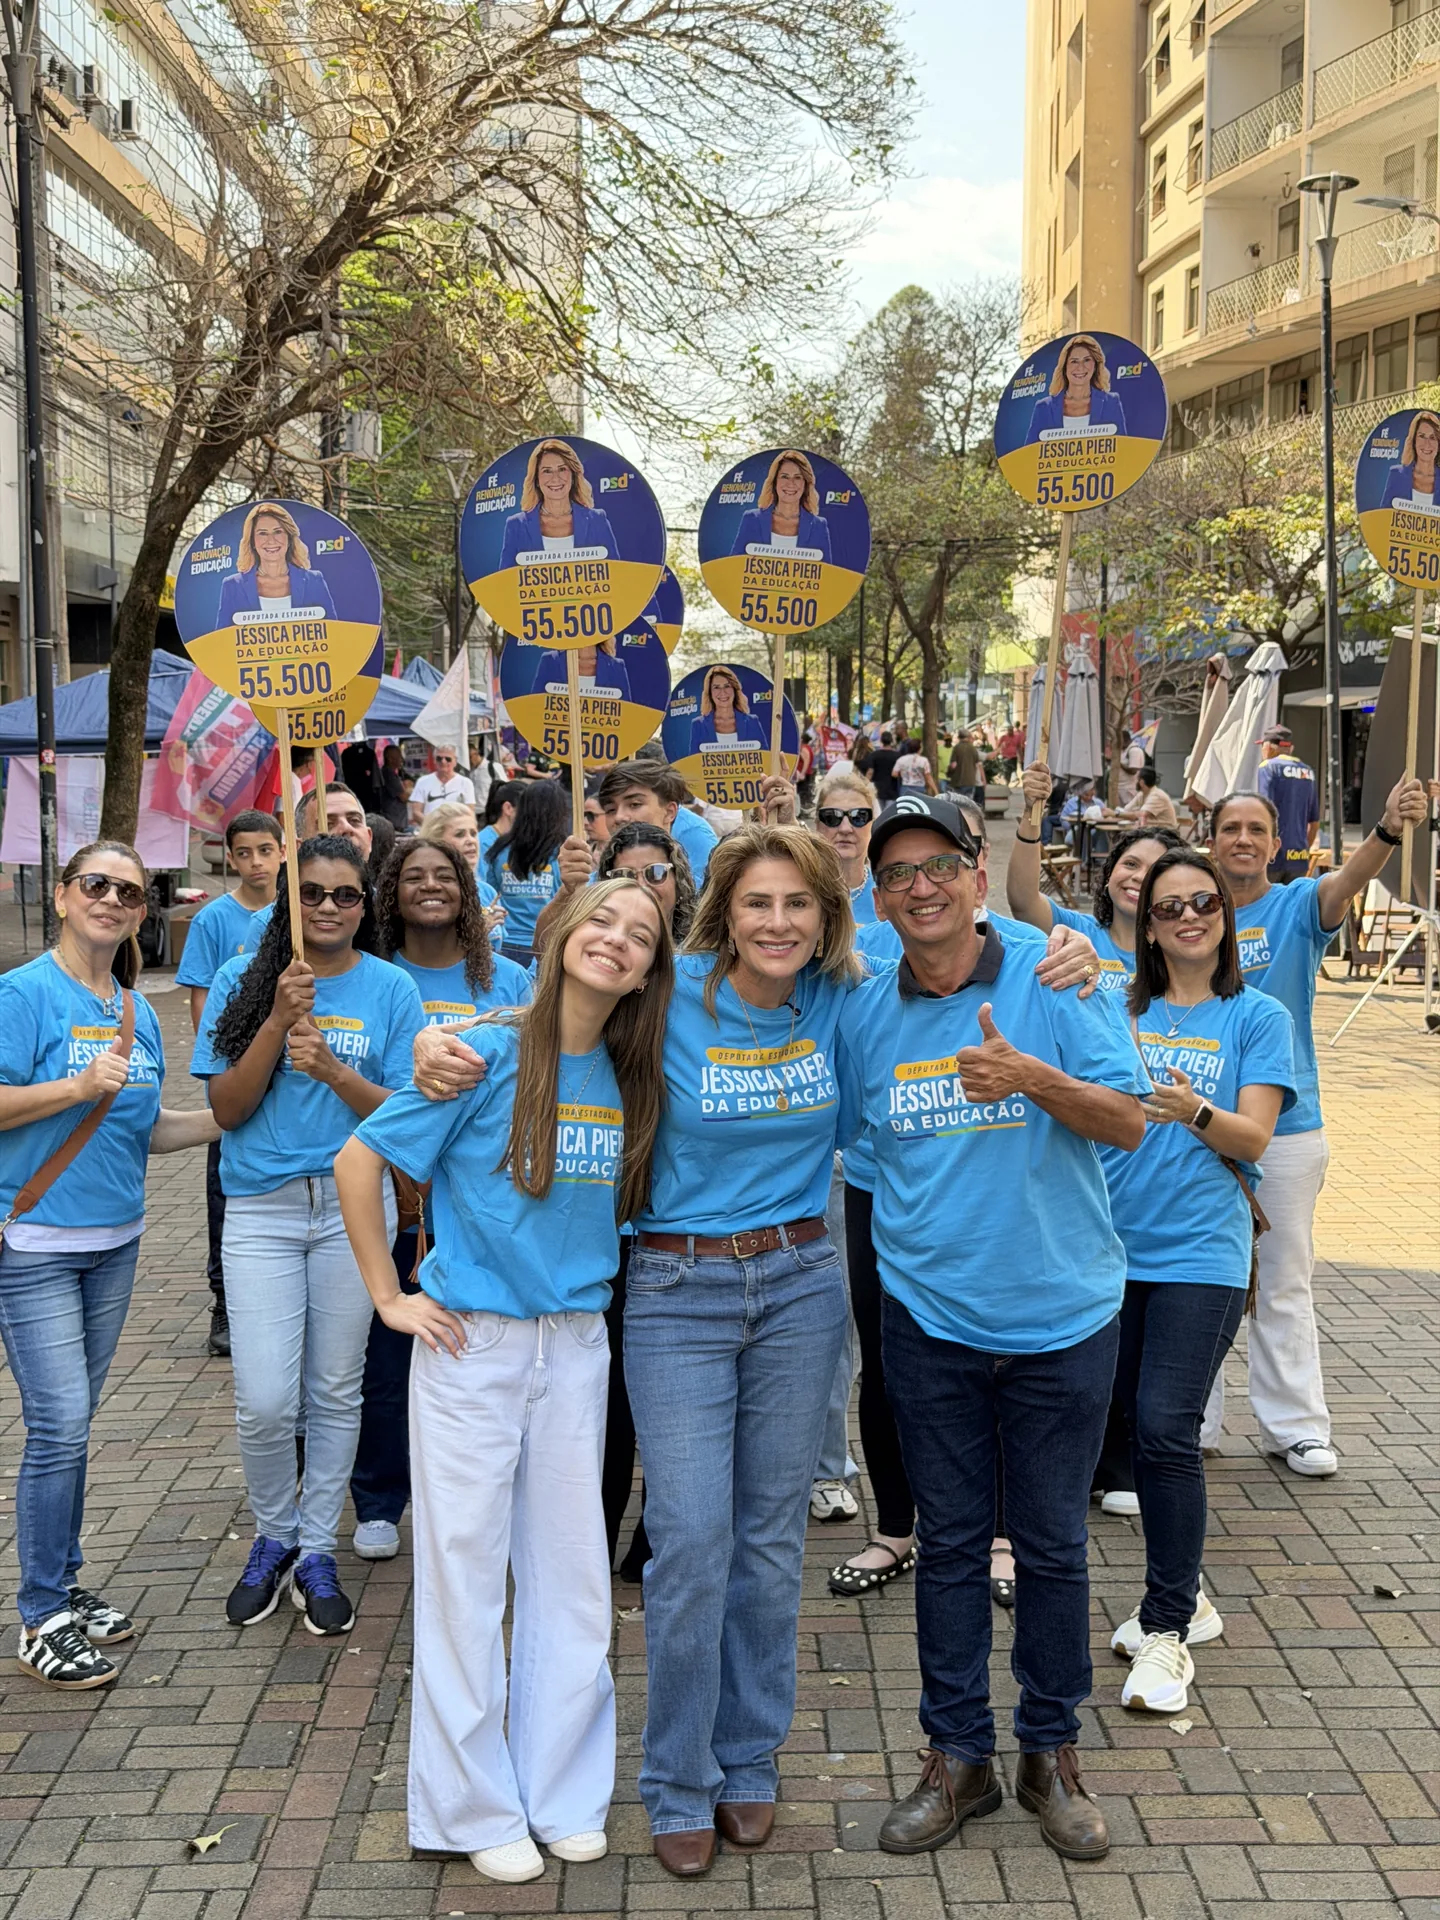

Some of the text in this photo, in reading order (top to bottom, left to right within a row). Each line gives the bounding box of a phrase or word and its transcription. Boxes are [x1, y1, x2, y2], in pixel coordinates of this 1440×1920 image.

[1025, 364, 1034, 377] FÉ
[1117, 361, 1142, 379] psd
[1011, 382, 1046, 400] EDUCAÇÃO
[1038, 438, 1116, 460] JÉSSICA PIERI
[1038, 455, 1115, 470] DA EDUCAÇÃO
[488, 472, 498, 488] FÉ
[600, 472, 628, 493] psd
[733, 470, 744, 483] FÉ
[476, 484, 514, 501] RENOVAÇÃO
[825, 490, 851, 505] psd
[1037, 472, 1114, 506] 55.500
[475, 495, 516, 514] EDUCAÇÃO
[718, 492, 755, 505] EDUCAÇÃO
[1391, 510, 1427, 533] JÉSSICA
[203, 535, 214, 550] FÉ
[1390, 530, 1402, 538] DA
[191, 545, 231, 563] RENOVAÇÃO
[316, 535, 344, 556] psd
[525, 549, 599, 562] DEPUTADA ESTADUAL
[190, 556, 232, 575] EDUCAÇÃO
[518, 562, 610, 587] JÉSSICA PIERI
[744, 556, 822, 580] JÉSSICA PIERI
[519, 583, 610, 599] DA EDUCAÇÃO
[743, 576, 820, 591] DA EDUCAÇÃO
[242, 610, 316, 621] DEPUTADA ESTADUAL
[740, 593, 818, 627] 55.500
[522, 602, 613, 641] 55.500
[236, 622, 328, 646] JÉSSICA PIERI
[622, 632, 647, 647] psd
[236, 643, 329, 658] DA EDUCAÇÃO
[239, 661, 332, 699] 55.500
[753, 690, 772, 704] psd
[544, 713, 558, 721] DA
[592, 700, 621, 717] PIERI
[543, 728, 619, 761] 55500
[702, 752, 763, 768] JÉSSICA PIERI
[703, 766, 764, 776] DA EDUCAÇÃO
[326, 1031, 370, 1058] PIERI
[718, 1052, 764, 1061] DEPUTADA
[1175, 1050, 1225, 1080] PIERI
[700, 1050, 831, 1094] JÉSSICA PIERI
[907, 1062, 949, 1075] DEPUTADA
[702, 1081, 835, 1113] DA EDUAÇÃO
[889, 1078, 967, 1115] JÉSSICA
[579, 1109, 615, 1120] ESTADUAL
[891, 1101, 1025, 1133] DA EDUCAÇÃO
[592, 1127, 624, 1158] PIER
